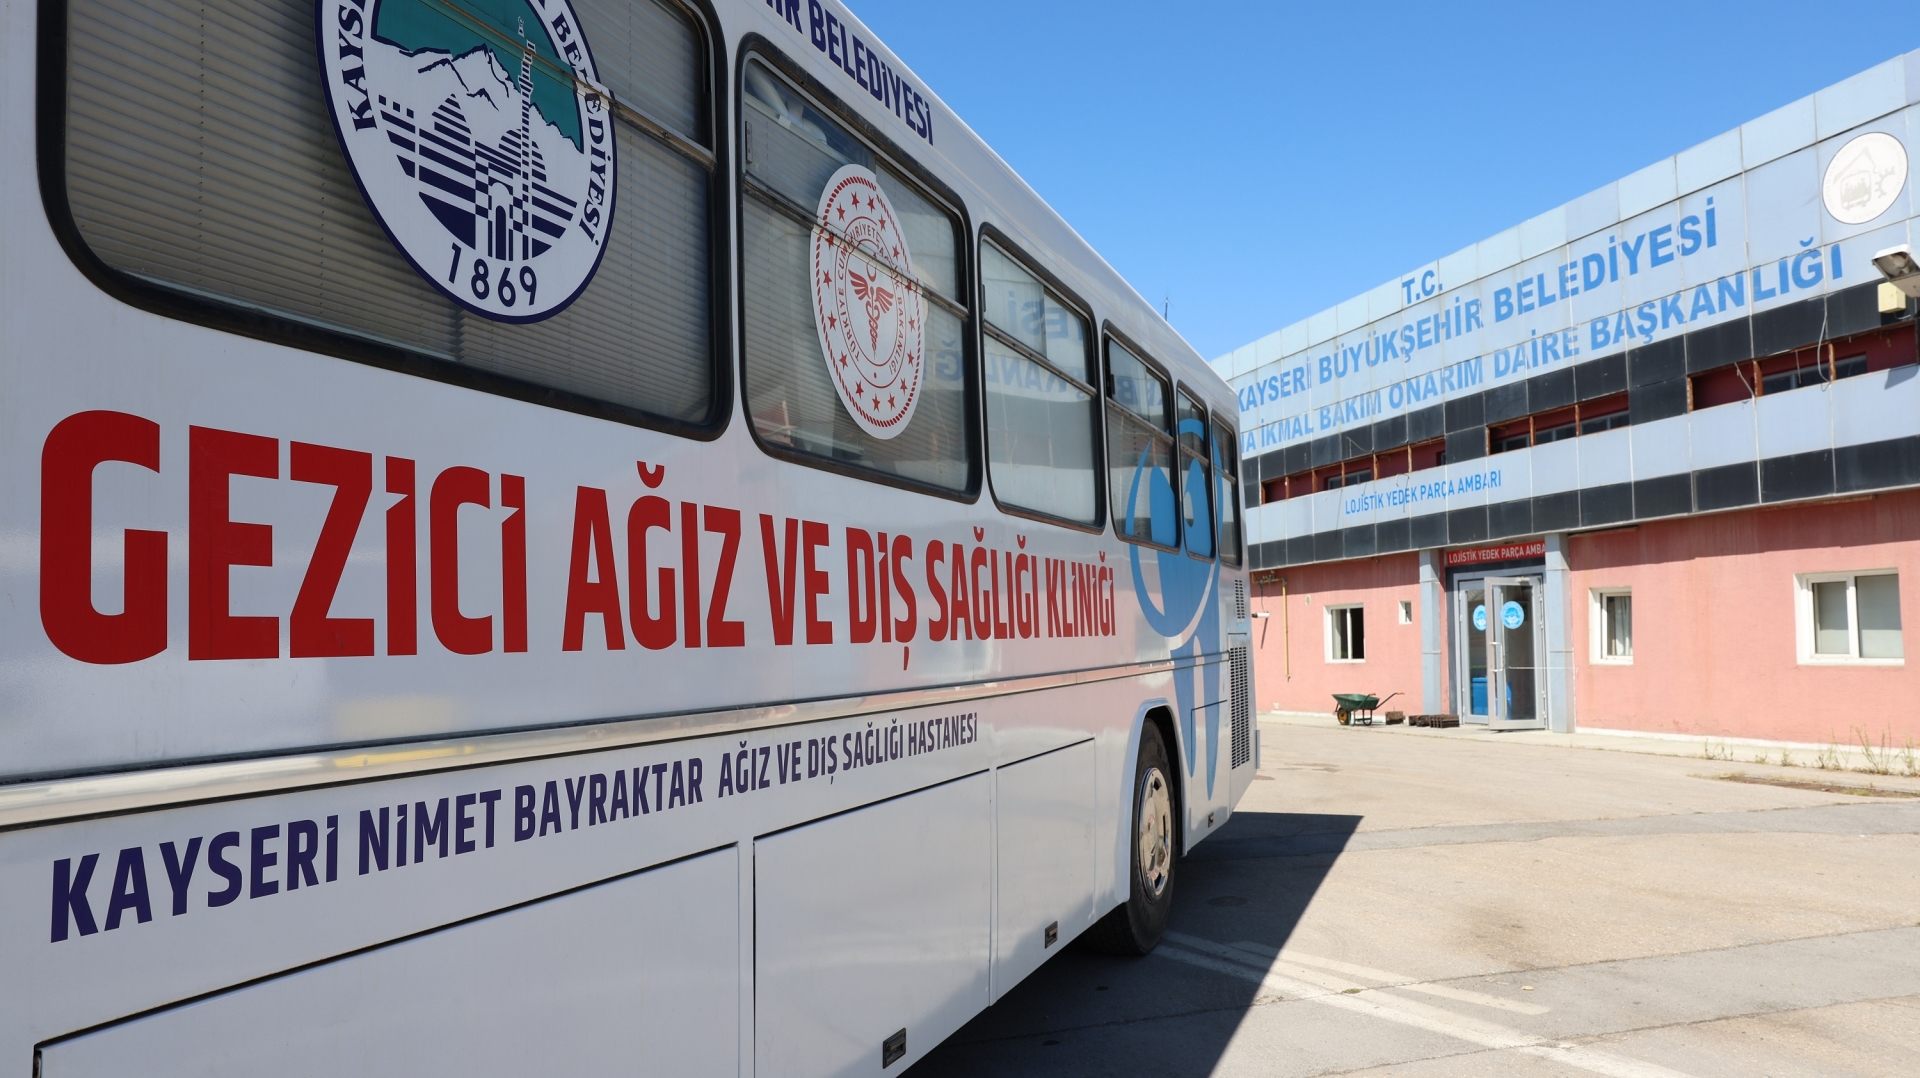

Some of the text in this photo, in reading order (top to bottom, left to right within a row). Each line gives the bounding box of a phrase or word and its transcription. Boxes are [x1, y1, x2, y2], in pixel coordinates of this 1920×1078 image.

[338, 0, 378, 132] KAYS
[808, 0, 934, 147] BELEDİYESİ
[448, 242, 538, 308] 1869
[1238, 197, 1717, 412] KAYSERİ BÜYÜKŞEHİR BELEDİYESİ
[1261, 418, 1314, 447] İKMAL
[1319, 390, 1382, 430] BAKIM
[1388, 356, 1484, 410] ONARIM
[1494, 329, 1580, 379] DAİRE
[1590, 237, 1844, 351] BAŞKANLIĞI
[1402, 269, 1443, 305] T.C.
[39, 409, 1117, 671] GEZİCİ AĞIZ VE DİŞ SAĞLIĞI KLİNİĞİ
[1345, 470, 1502, 514] LOJİSTİK YEDEK PARÇA AMBARI
[1449, 549, 1477, 563] LOJİSTİK
[1478, 548, 1500, 560] YEDEK
[1501, 546, 1524, 558] PARÇA
[50, 712, 978, 943] KAYSERİ NİMET BAYRAKTAR AĞIZ VE DİŞ SAĞLIĞI HASTANESİ
